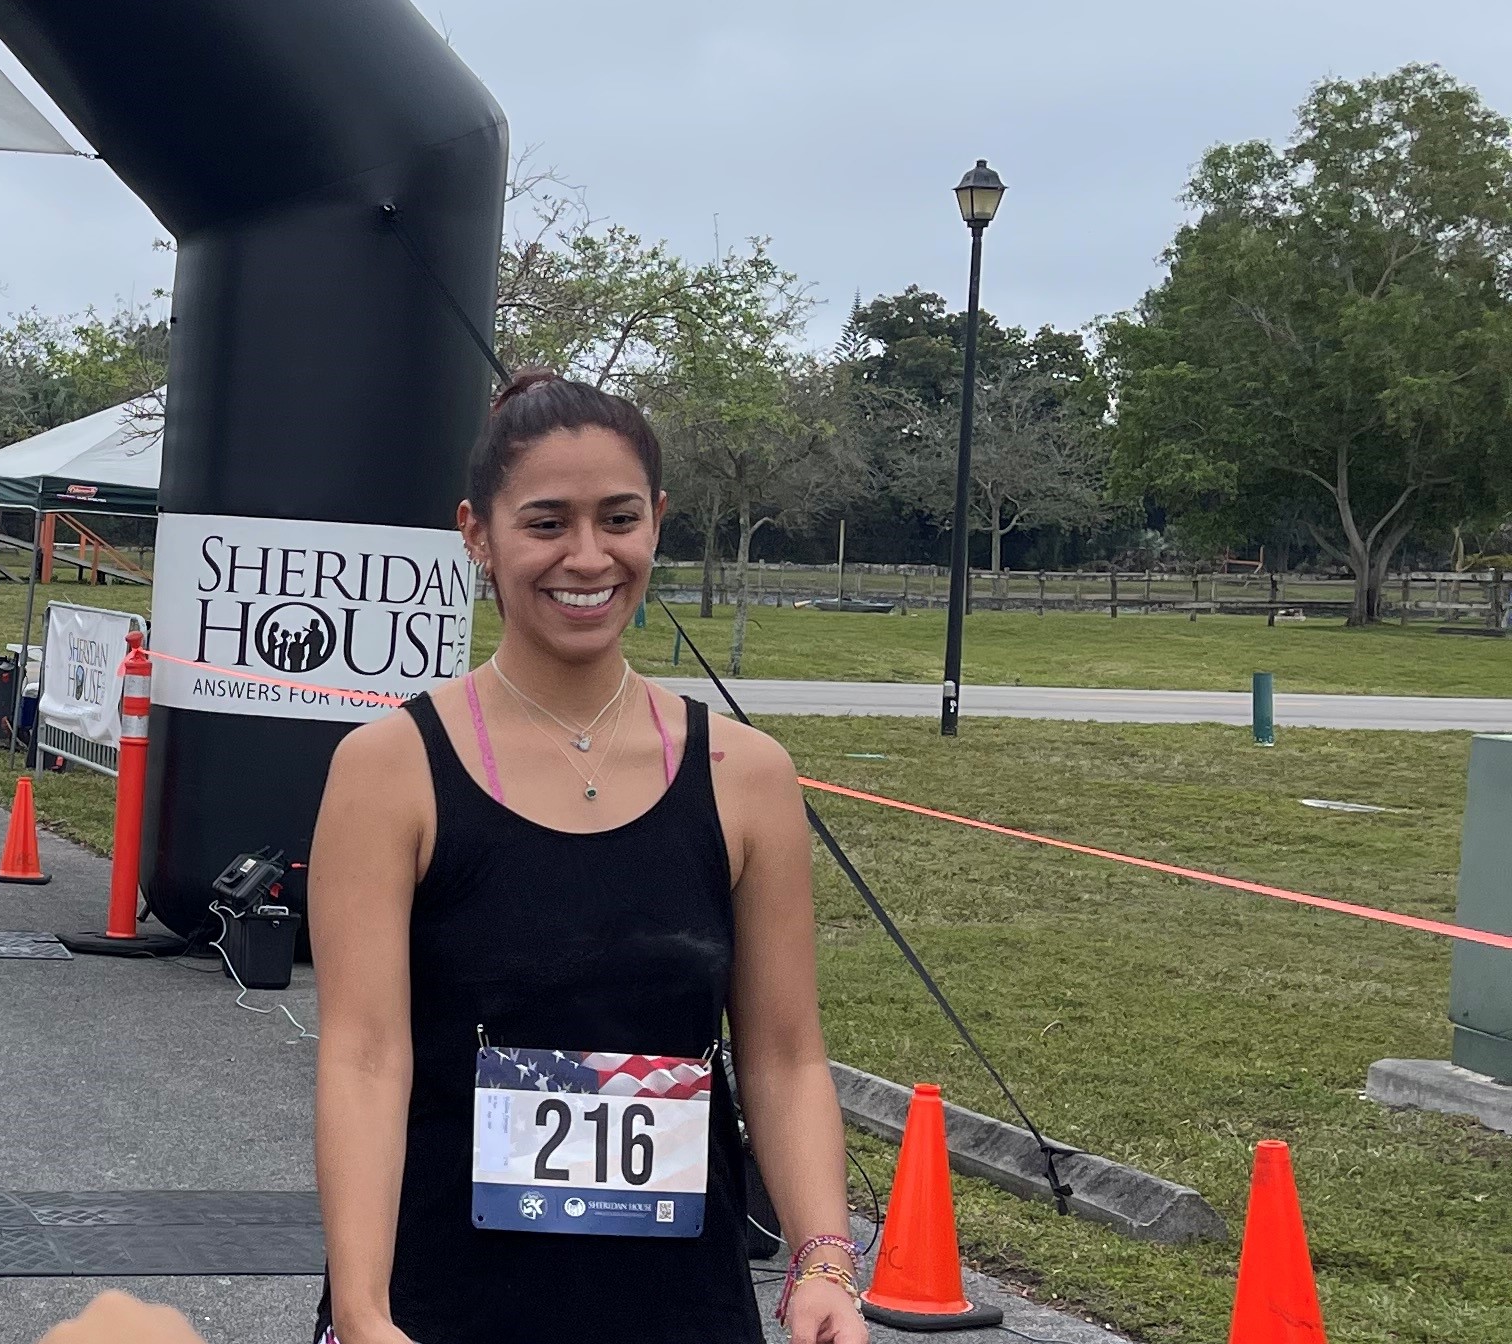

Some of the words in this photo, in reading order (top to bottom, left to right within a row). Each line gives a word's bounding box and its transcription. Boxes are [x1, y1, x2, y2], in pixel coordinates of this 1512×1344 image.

[197, 535, 472, 607] SHERIDAN
[193, 598, 458, 679] HOUSE
[192, 678, 281, 702] ANSWERS
[289, 686, 330, 706] FOR
[534, 1098, 655, 1185] 216
